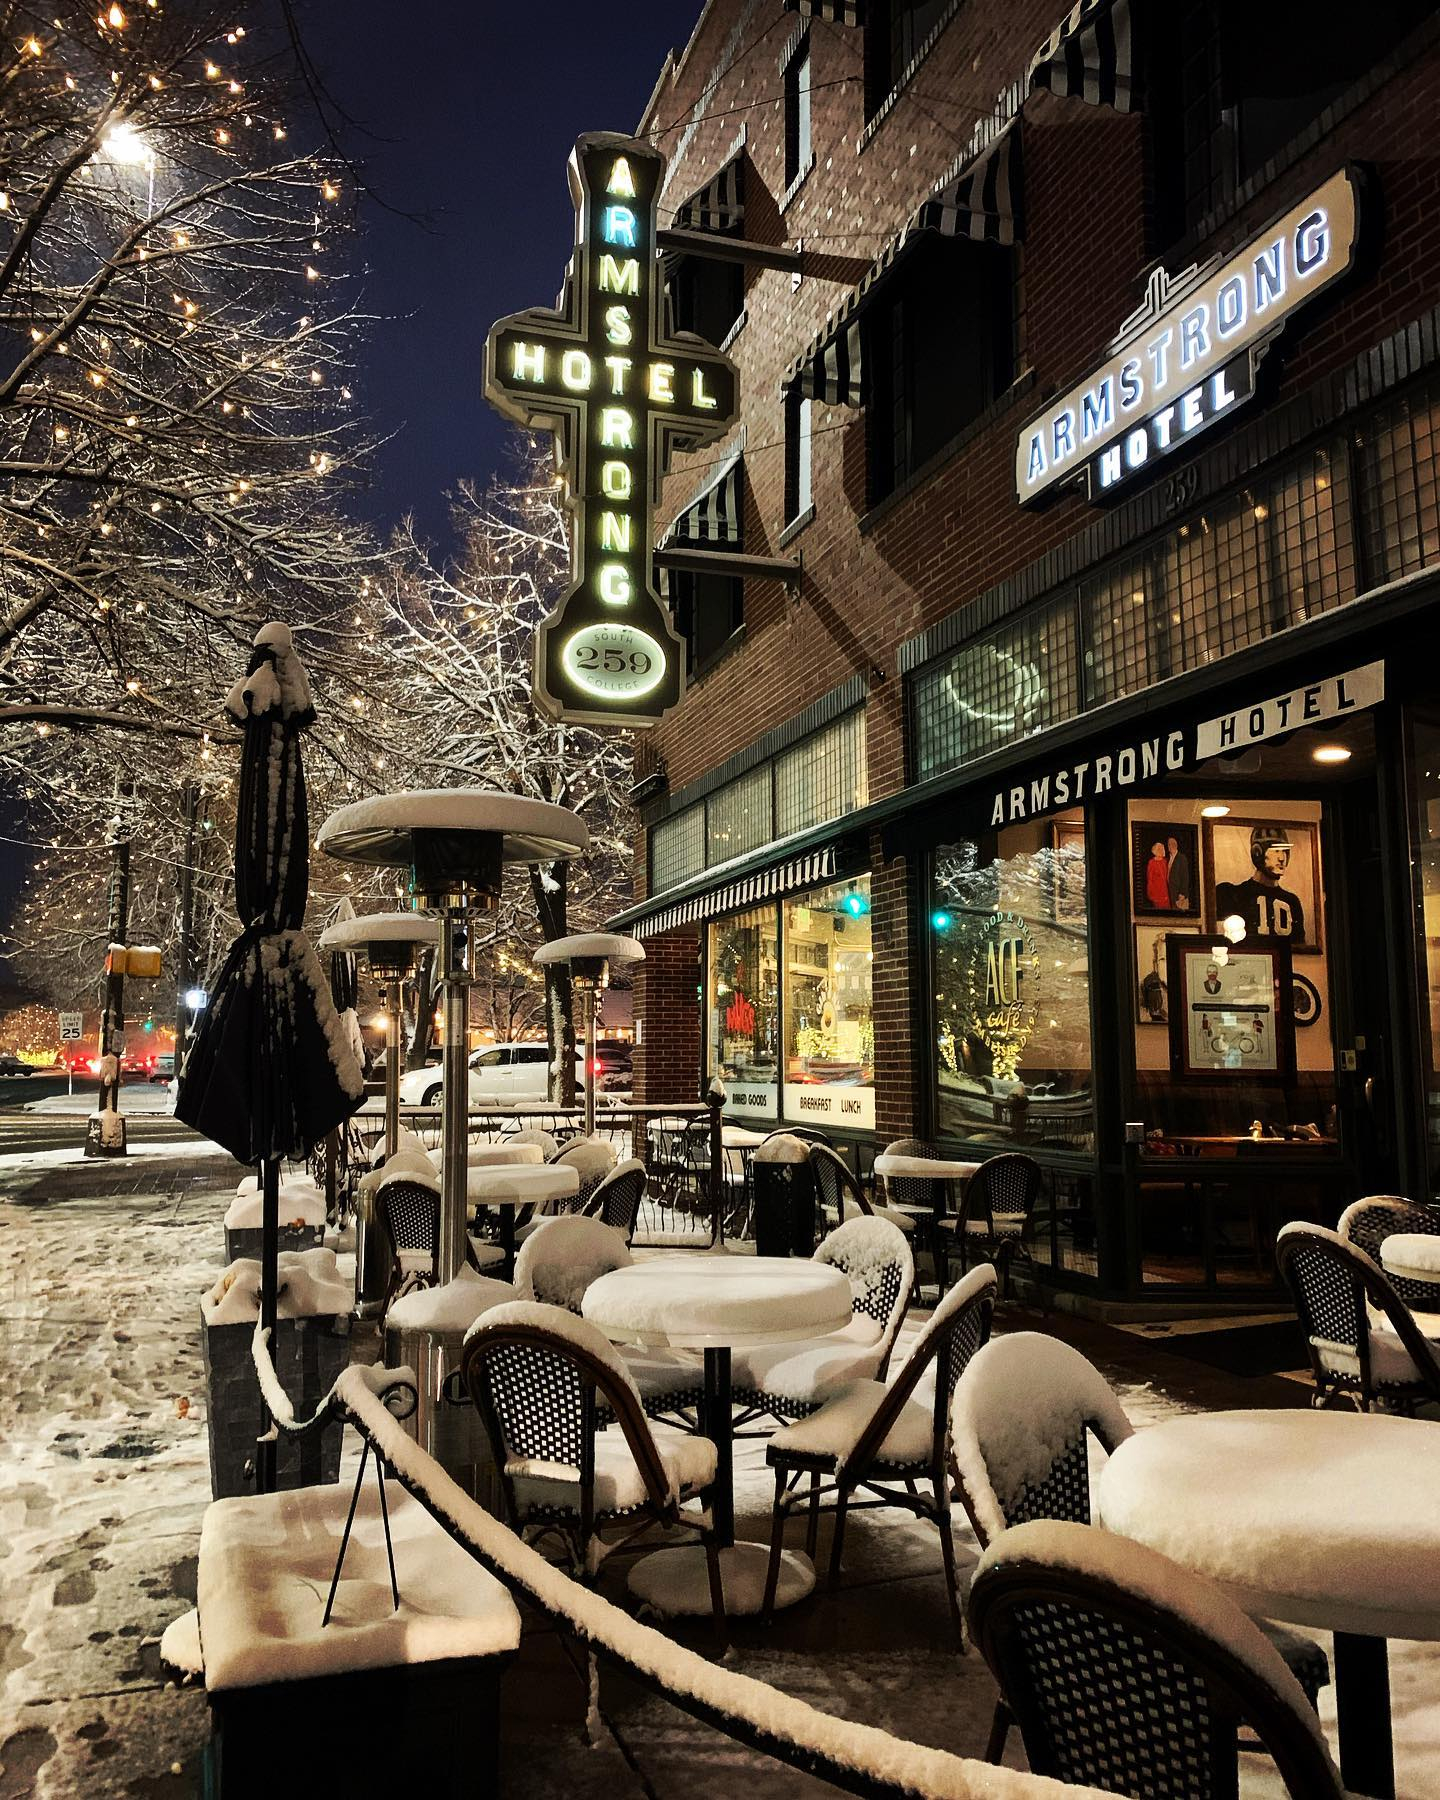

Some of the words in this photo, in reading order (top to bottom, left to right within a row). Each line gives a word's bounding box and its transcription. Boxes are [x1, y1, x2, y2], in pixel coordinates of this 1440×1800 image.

[1028, 207, 1330, 485] ARMSTRONG
[512, 341, 717, 408] HOTEL
[600, 157, 640, 605] ARMSTRONG
[1102, 370, 1236, 487] HOTEL
[1165, 464, 1197, 513] 259
[594, 632, 633, 644] SOUTH
[577, 647, 652, 674] 259
[586, 675, 640, 690] COLLEGE
[990, 731, 1184, 827] ARMSTRONG
[1221, 678, 1356, 747] HOTEL
[978, 911, 1004, 941] FOOD
[1008, 910, 1015, 924] &
[1257, 896, 1292, 935] 10
[62, 1028, 80, 1038] 25
[748, 1093, 766, 1107] GOODS
[800, 1097, 832, 1112] BREAKFAST
[841, 1099, 862, 1114] LUNCH
